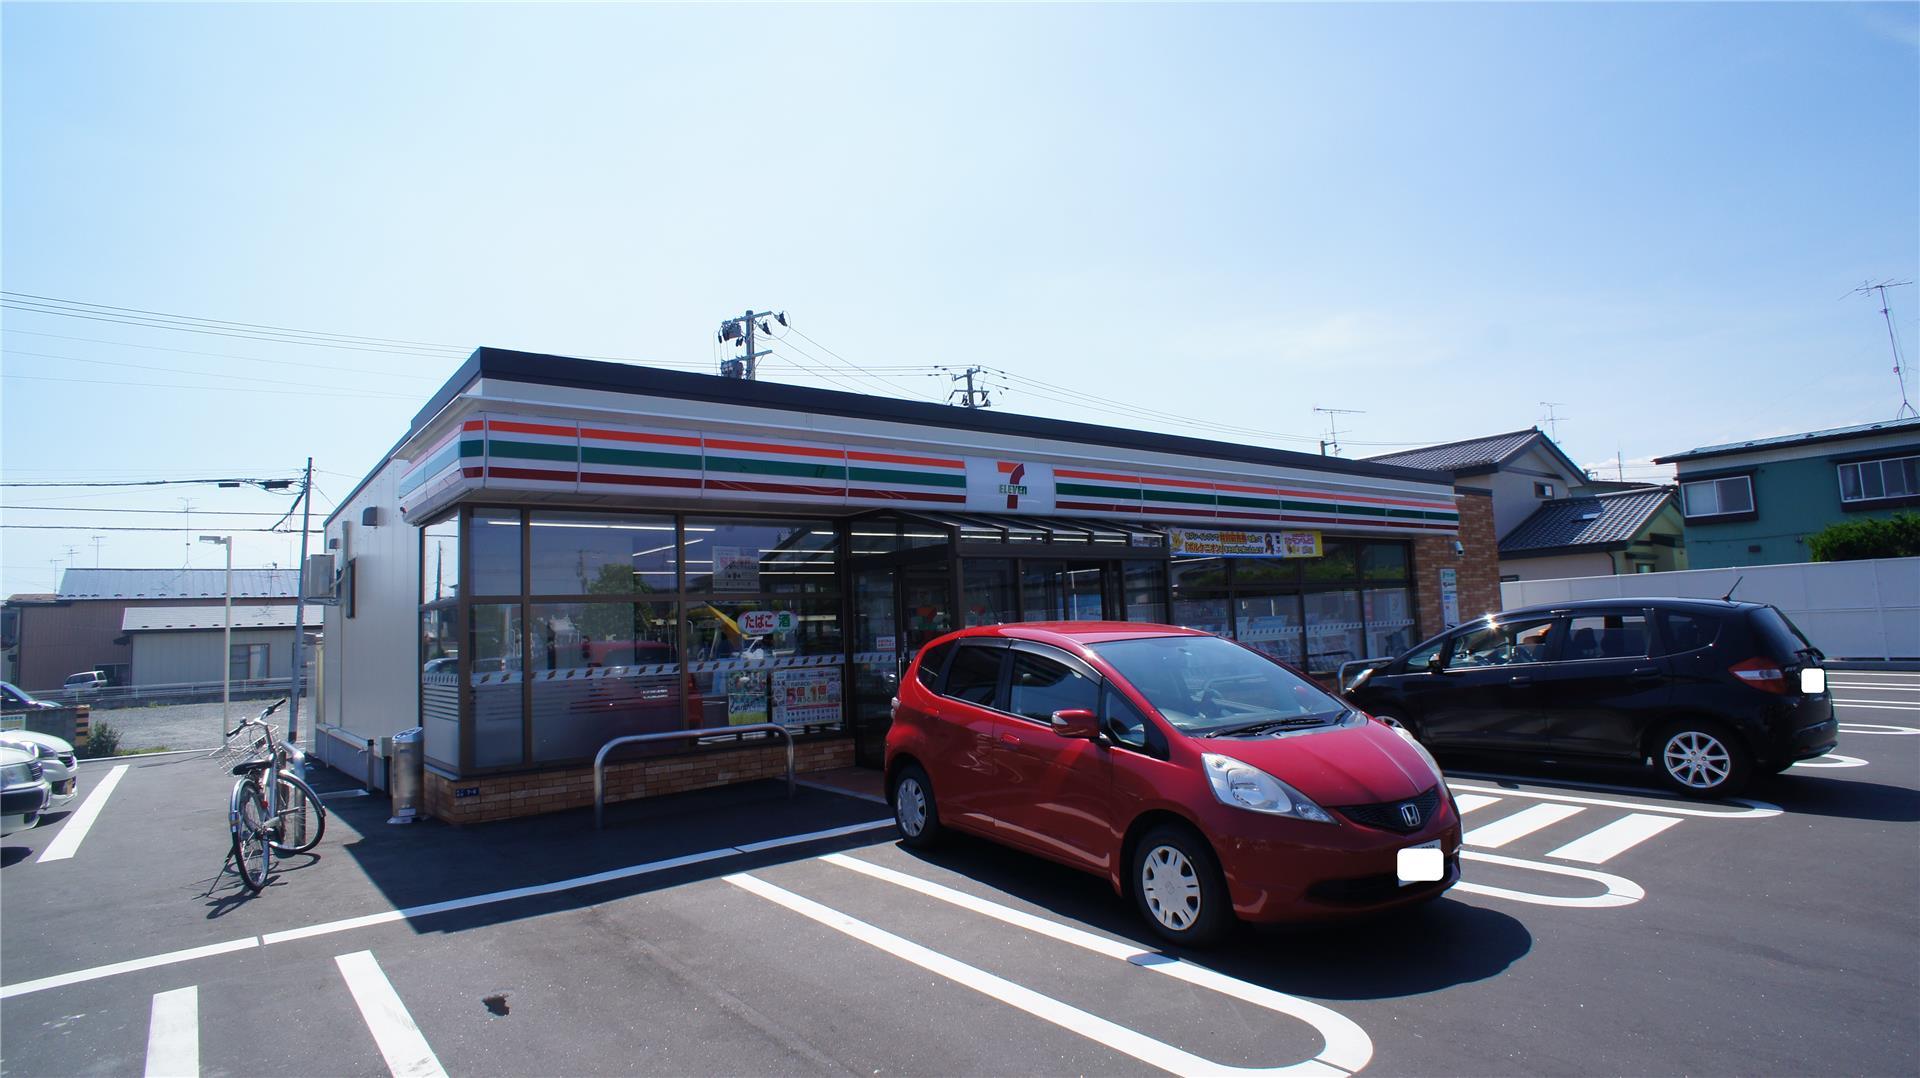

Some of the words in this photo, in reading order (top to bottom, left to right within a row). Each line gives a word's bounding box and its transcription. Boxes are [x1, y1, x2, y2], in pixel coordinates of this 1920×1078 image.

[745, 614, 773, 629] たばこ
[778, 614, 790, 627] 酒
